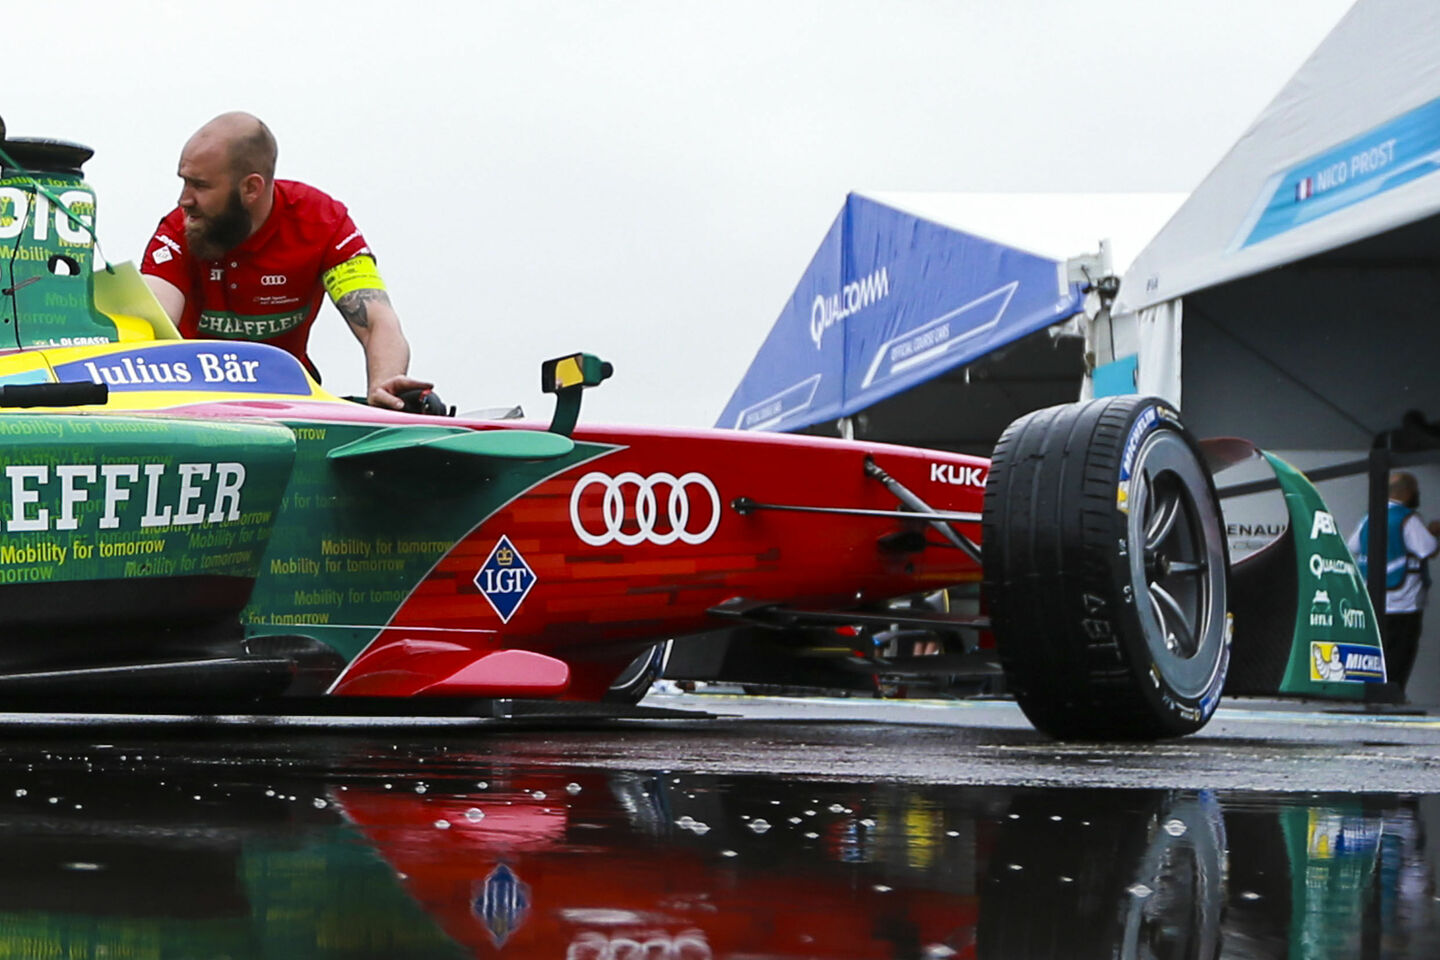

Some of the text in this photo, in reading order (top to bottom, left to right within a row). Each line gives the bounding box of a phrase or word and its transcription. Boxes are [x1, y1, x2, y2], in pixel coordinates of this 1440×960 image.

[1317, 138, 1397, 192] NICO PROST
[810, 266, 890, 350] QUALCOMM
[197, 352, 259, 383] Bär
[68, 420, 92, 434] for
[0, 538, 165, 565] Mobility for tomorrow
[322, 539, 372, 558] Mobility
[375, 539, 393, 553] for
[270, 553, 320, 574] Mobility
[326, 557, 341, 572] for
[347, 556, 405, 571] tomorrow
[485, 568, 527, 594] LGT
[294, 590, 345, 608] Mobility
